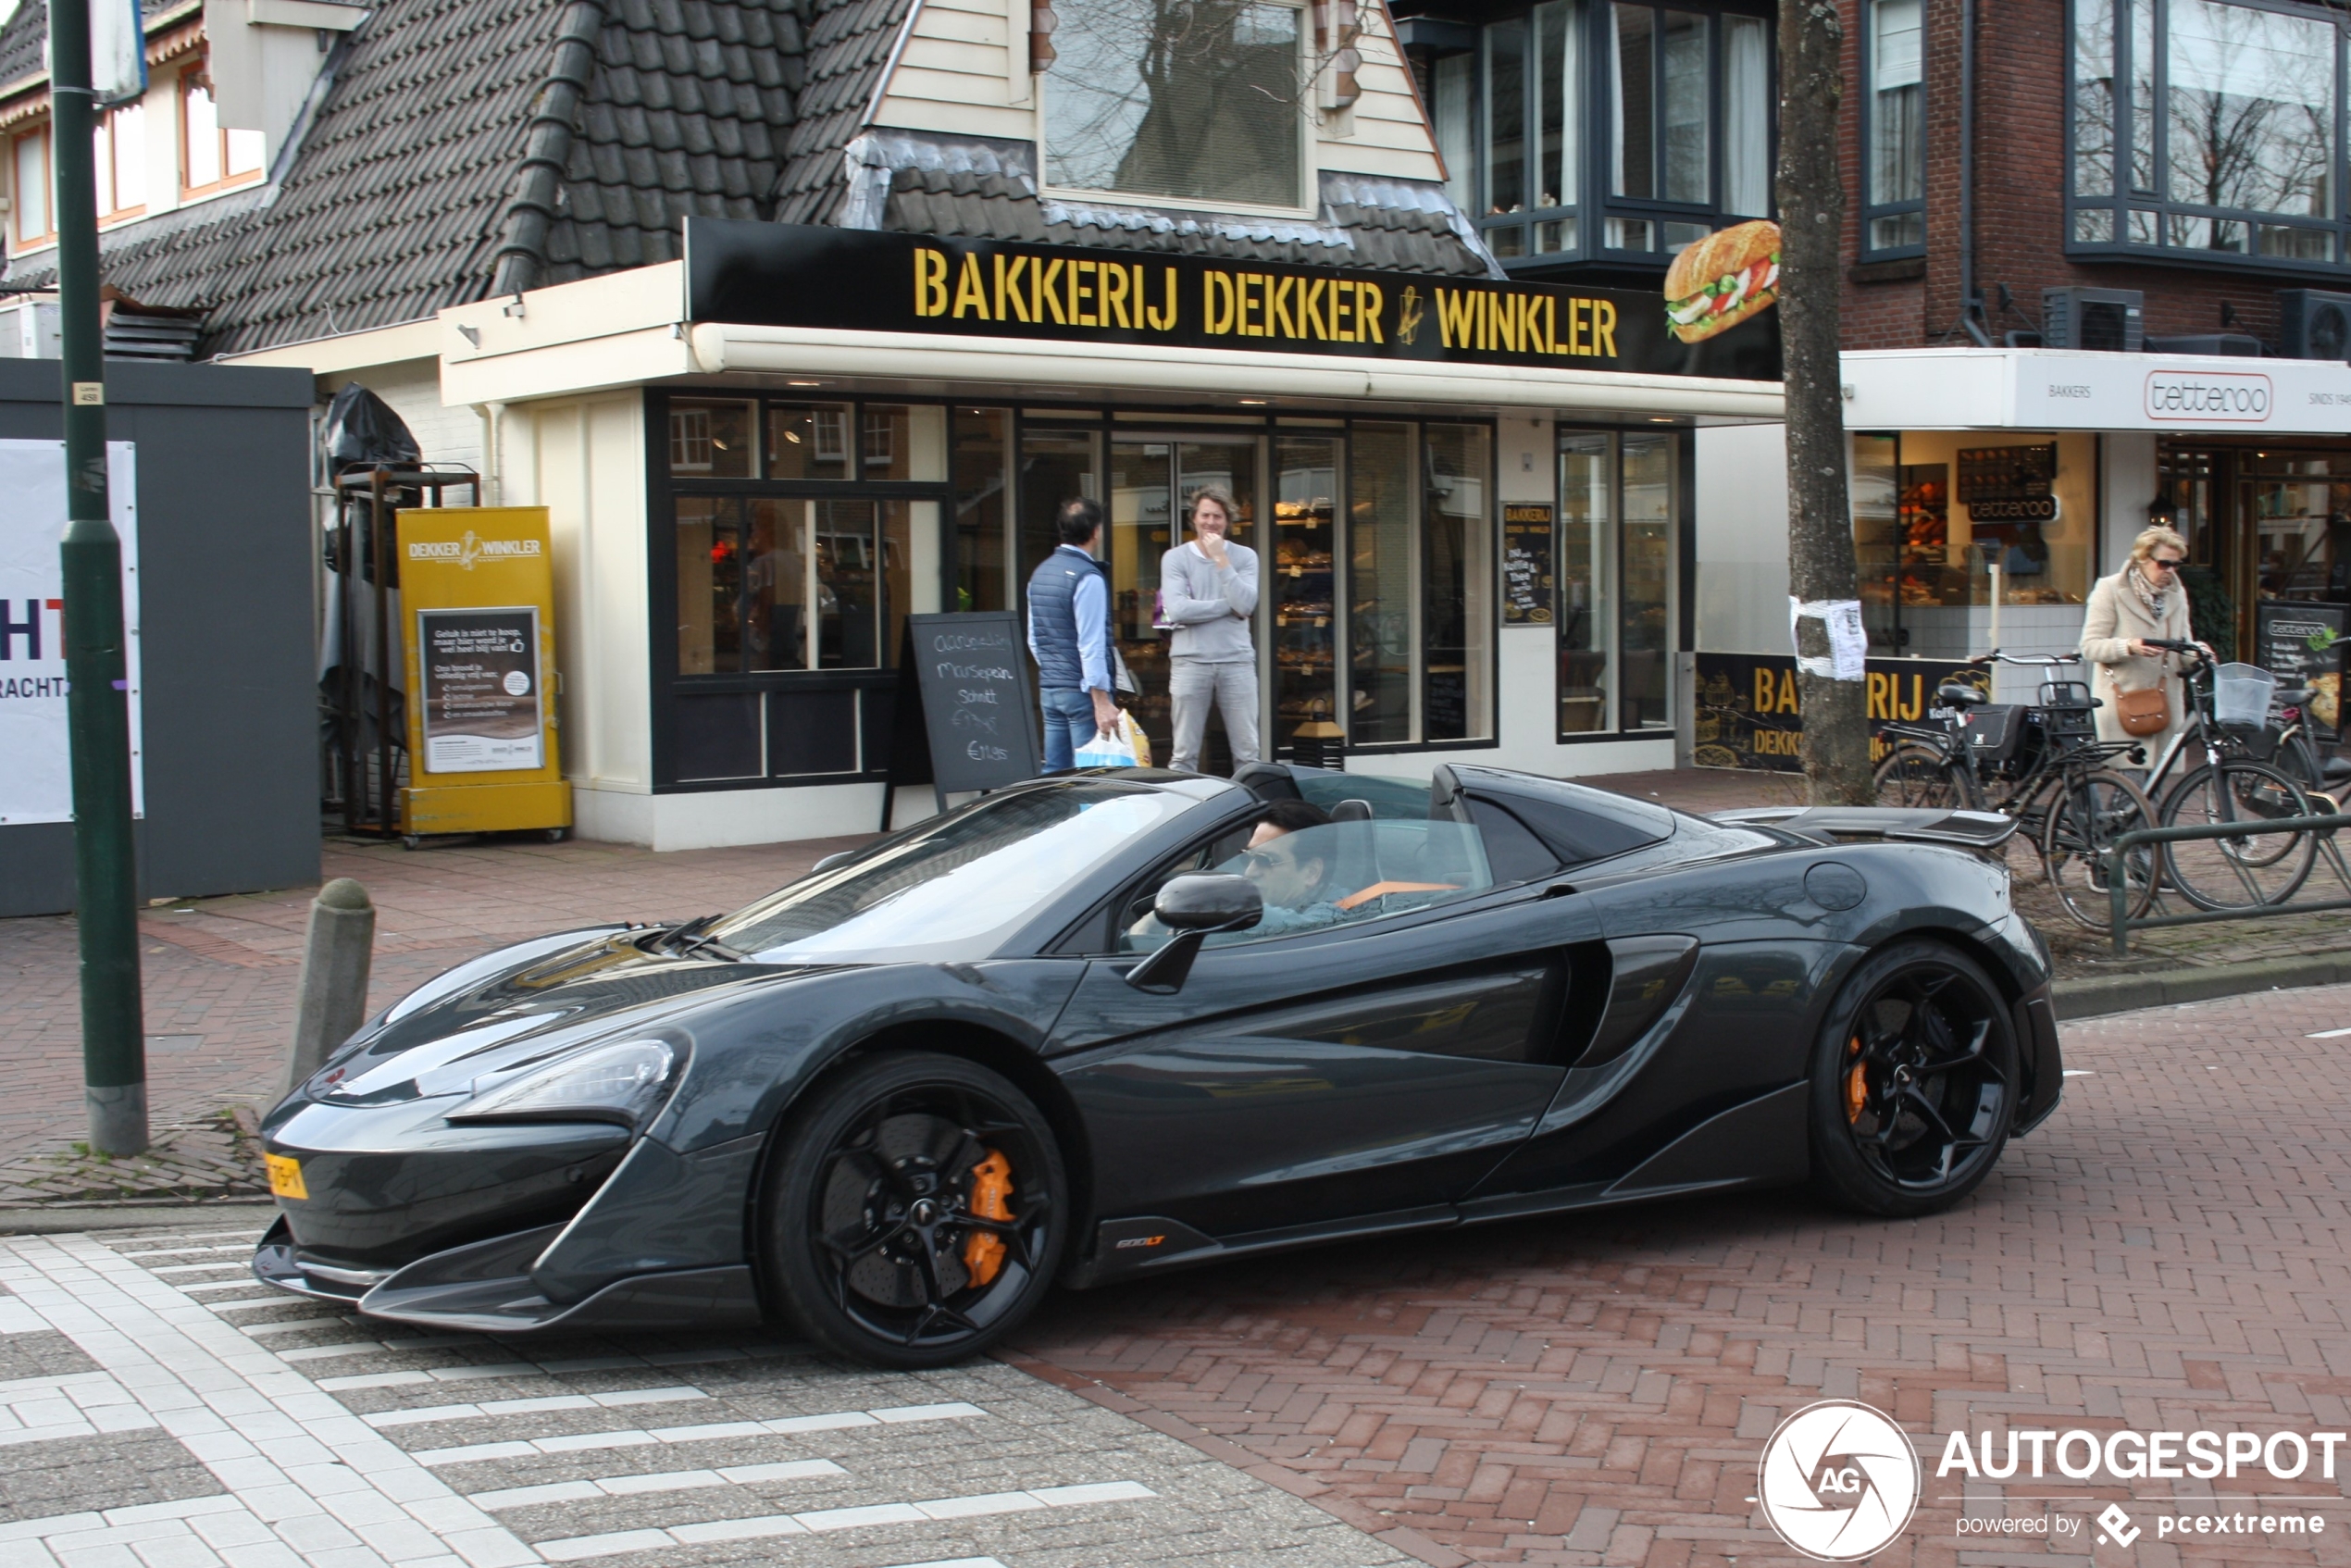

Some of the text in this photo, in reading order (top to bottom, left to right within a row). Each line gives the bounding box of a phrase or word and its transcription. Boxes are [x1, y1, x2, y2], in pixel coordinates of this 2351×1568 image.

[914, 248, 1618, 358] BAKKERIJ DEKKER WINKLER
[2048, 384, 2091, 399] BAKKERS
[2152, 380, 2268, 413] tetteroo
[2308, 392, 2333, 405] SINDS
[1971, 500, 2053, 517] tetteroo
[409, 540, 541, 557] DEKKER WINKLER
[1115, 1235, 1165, 1250] 600LT
